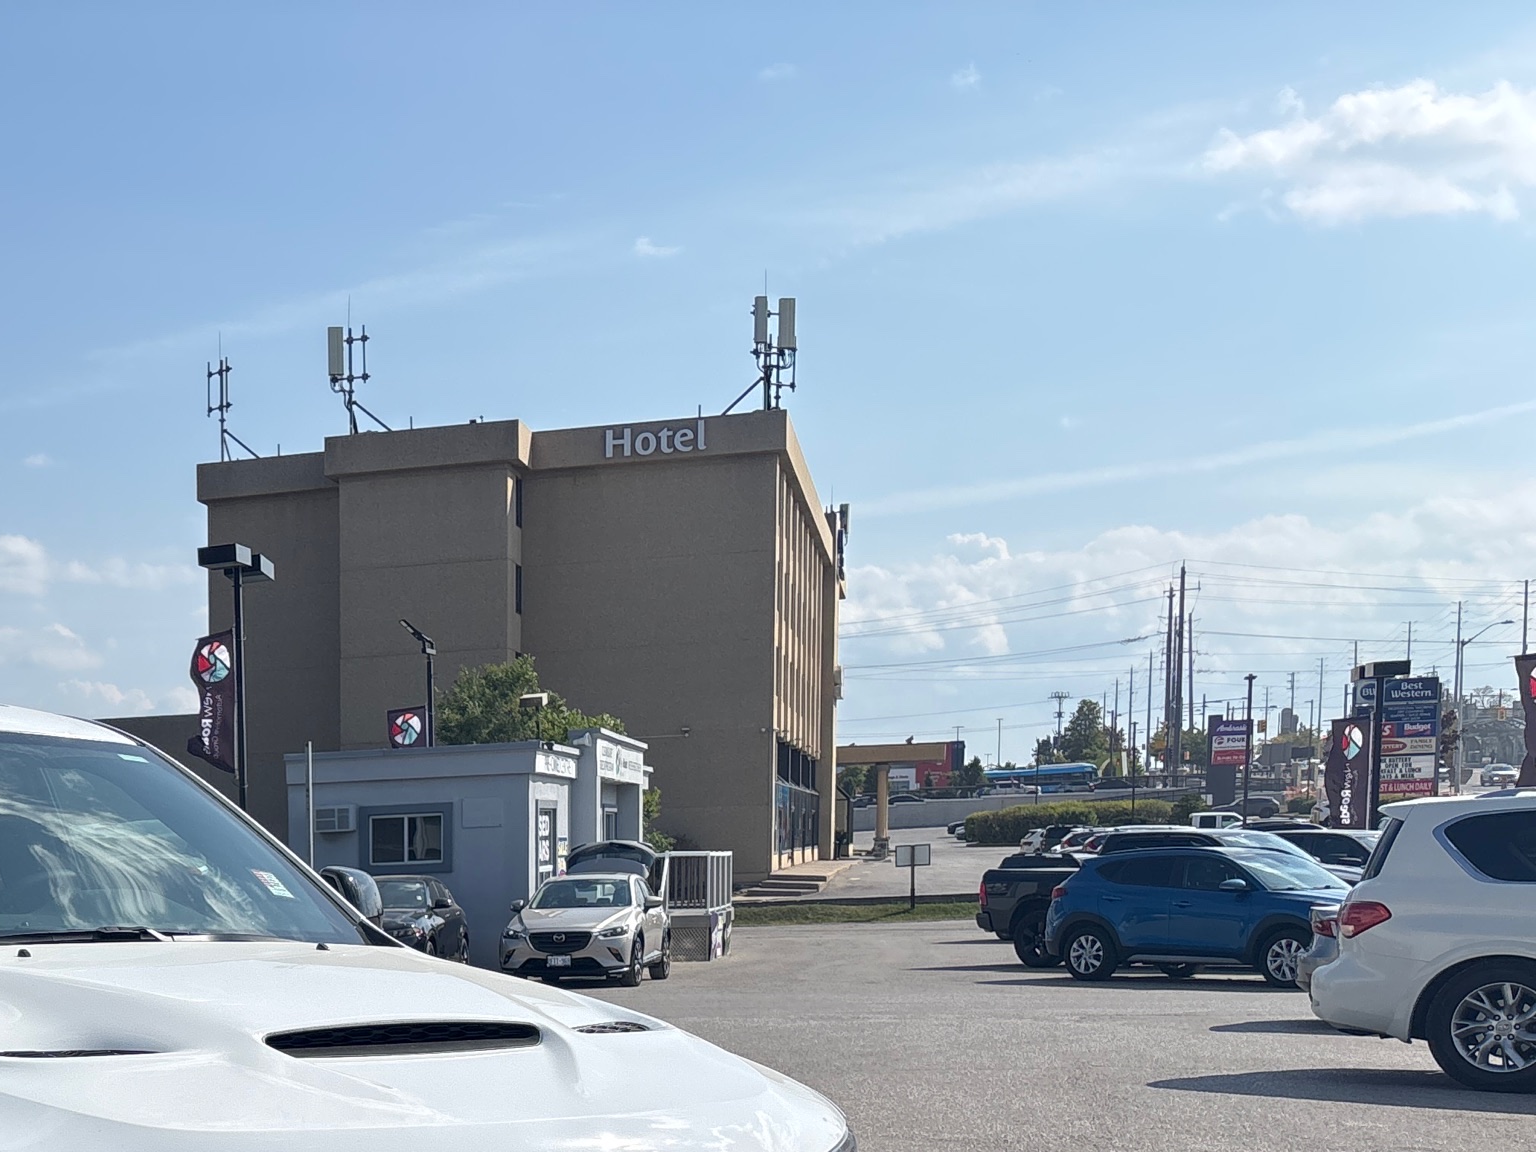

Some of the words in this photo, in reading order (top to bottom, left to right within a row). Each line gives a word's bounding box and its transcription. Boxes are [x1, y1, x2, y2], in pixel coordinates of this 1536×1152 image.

[605, 419, 707, 458] Hotel
[1401, 681, 1423, 690] Best
[1391, 689, 1432, 698] Western
[1404, 723, 1432, 731] Budget
[1393, 782, 1415, 791] LUNCH
[1414, 782, 1433, 791] DAILY
